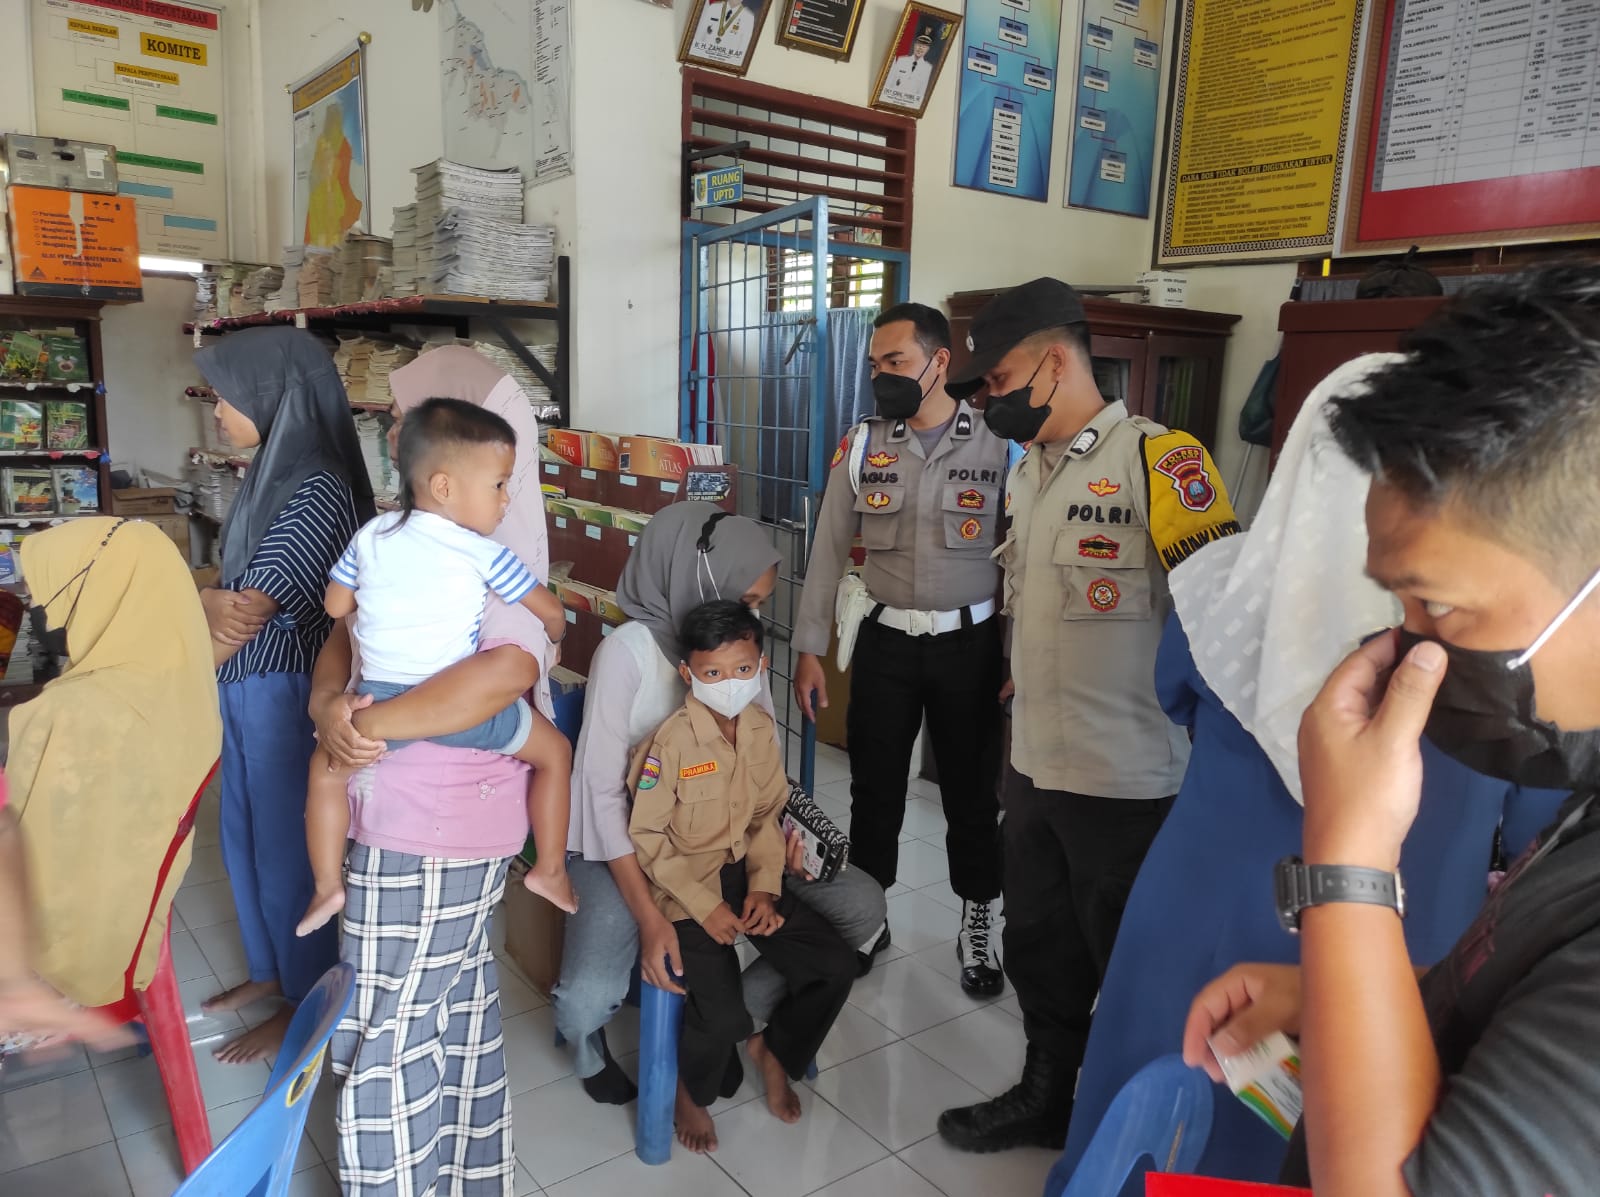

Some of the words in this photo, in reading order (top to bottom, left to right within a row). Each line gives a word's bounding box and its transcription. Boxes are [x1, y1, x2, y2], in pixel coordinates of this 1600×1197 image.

[147, 38, 201, 60] KOMITE
[712, 171, 740, 187] RUANG
[714, 188, 734, 201] UPTD
[660, 460, 682, 474] ATLAS
[861, 472, 898, 484] AGUS
[949, 469, 998, 483] POLRI
[1067, 504, 1132, 524] POLRI
[683, 762, 714, 777] PRAMUKA
